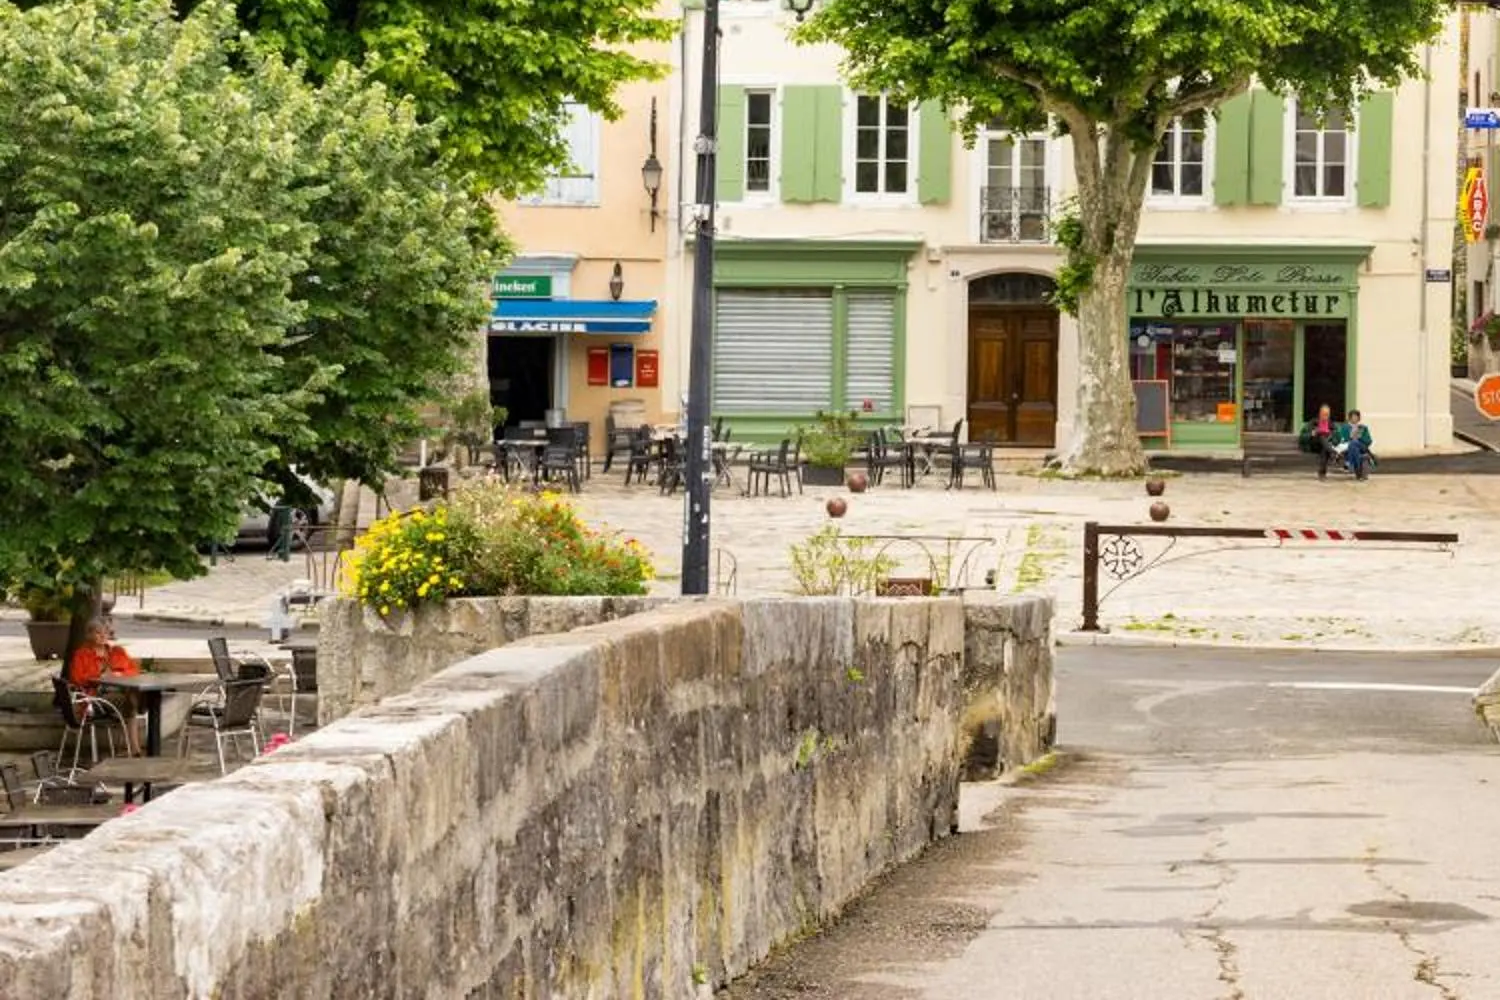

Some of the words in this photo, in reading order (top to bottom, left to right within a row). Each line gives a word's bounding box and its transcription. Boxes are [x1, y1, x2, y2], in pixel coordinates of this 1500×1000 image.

[1473, 178, 1483, 232] TABAC
[1134, 263, 1200, 283] Tabac
[1274, 265, 1344, 283] Presse
[495, 280, 536, 292] ineken
